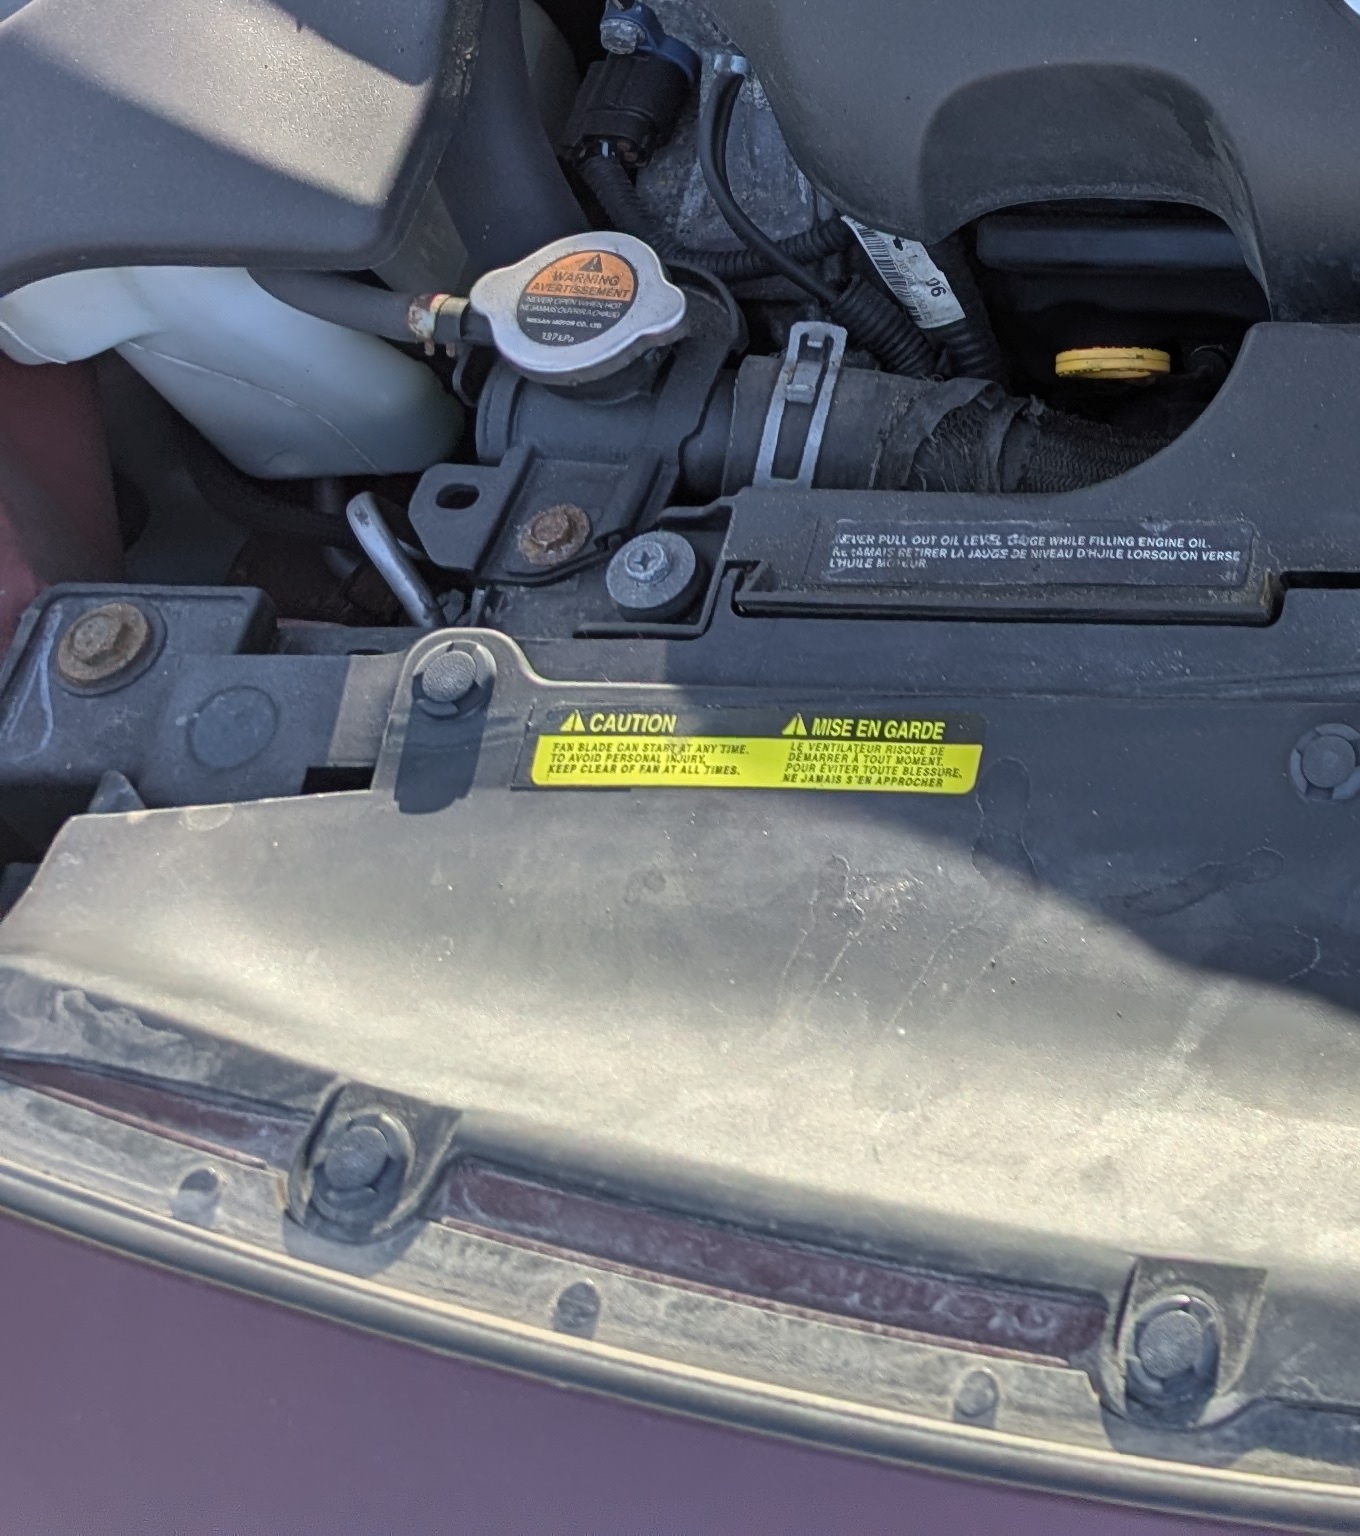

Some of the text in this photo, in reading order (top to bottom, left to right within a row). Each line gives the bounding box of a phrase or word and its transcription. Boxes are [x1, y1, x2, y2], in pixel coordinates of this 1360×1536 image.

[552, 270, 620, 286] WARNING
[530, 282, 631, 298] AVERTISSEMENT
[878, 534, 907, 546] PULL
[911, 534, 937, 546] OUT
[940, 534, 960, 546] OIL
[1049, 536, 1086, 546] WHILE
[1089, 536, 1135, 547] FILLING
[1138, 537, 1185, 548] ENGINE
[1188, 538, 1212, 549] OIL.
[950, 549, 965, 558] LA
[1010, 548, 1027, 559] DE
[1031, 549, 1073, 559] NIVEAU
[1127, 549, 1198, 561] LORSQU'ON
[1201, 550, 1241, 562] VERSE
[589, 713, 677, 733] CAUTION
[811, 717, 946, 740] MISE EN GARDE
[552, 742, 750, 755] FAN BLADE CAN START AT ANY TIME.
[790, 741, 945, 756] LE VENTILATEUR RISQUE DE
[551, 753, 566, 763] TO
[568, 753, 601, 763] AVOID
[605, 753, 662, 763] PERSONAL
[863, 754, 893, 764] TOUT
[896, 756, 944, 767] MOMENT.
[548, 764, 741, 776] KEEP CLEAR OF FAN AT ALL TIMES.
[784, 762, 817, 773] POUR
[863, 765, 899, 775] TOUTE
[782, 773, 798, 783] NE
[800, 773, 842, 784] JAMAIS
[876, 775, 944, 788] APPROCHER
